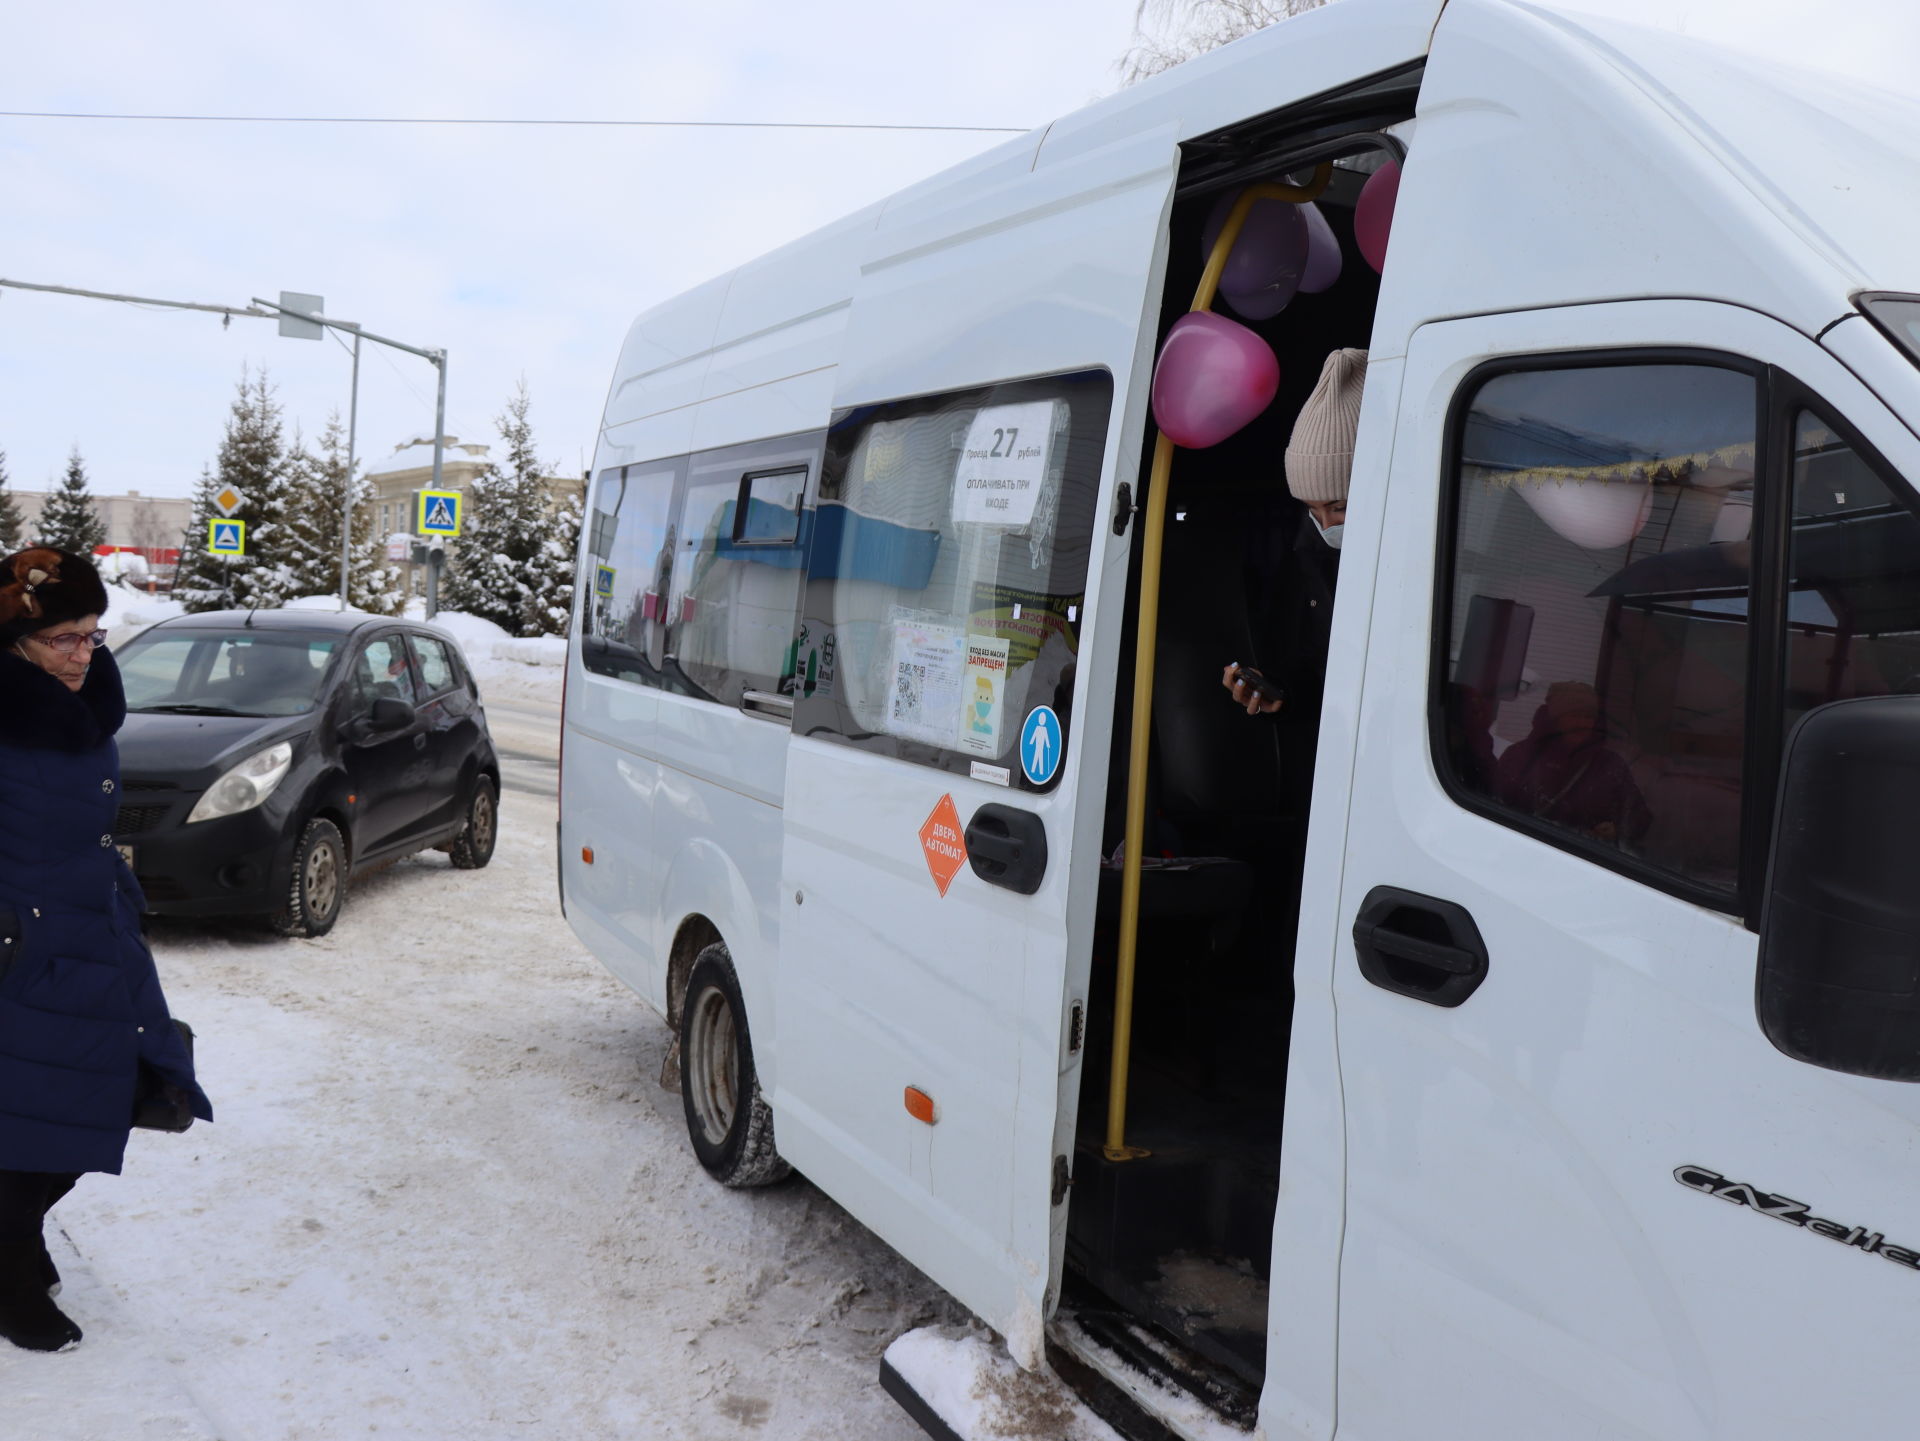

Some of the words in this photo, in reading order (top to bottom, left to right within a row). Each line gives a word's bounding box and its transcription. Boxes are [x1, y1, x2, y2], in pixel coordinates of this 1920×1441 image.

[990, 427, 1018, 458] 27
[1018, 446, 1041, 460] рублей
[966, 479, 1016, 490] ОПЛАЧИВАТЬ
[1016, 480, 1030, 490] ПРИ
[981, 648, 990, 656] БЕЗ
[968, 655, 1006, 671] ЗАПРЕЩЕН!
[932, 823, 957, 842] ДВЕРЬ
[925, 838, 962, 860] АВТОМАТ
